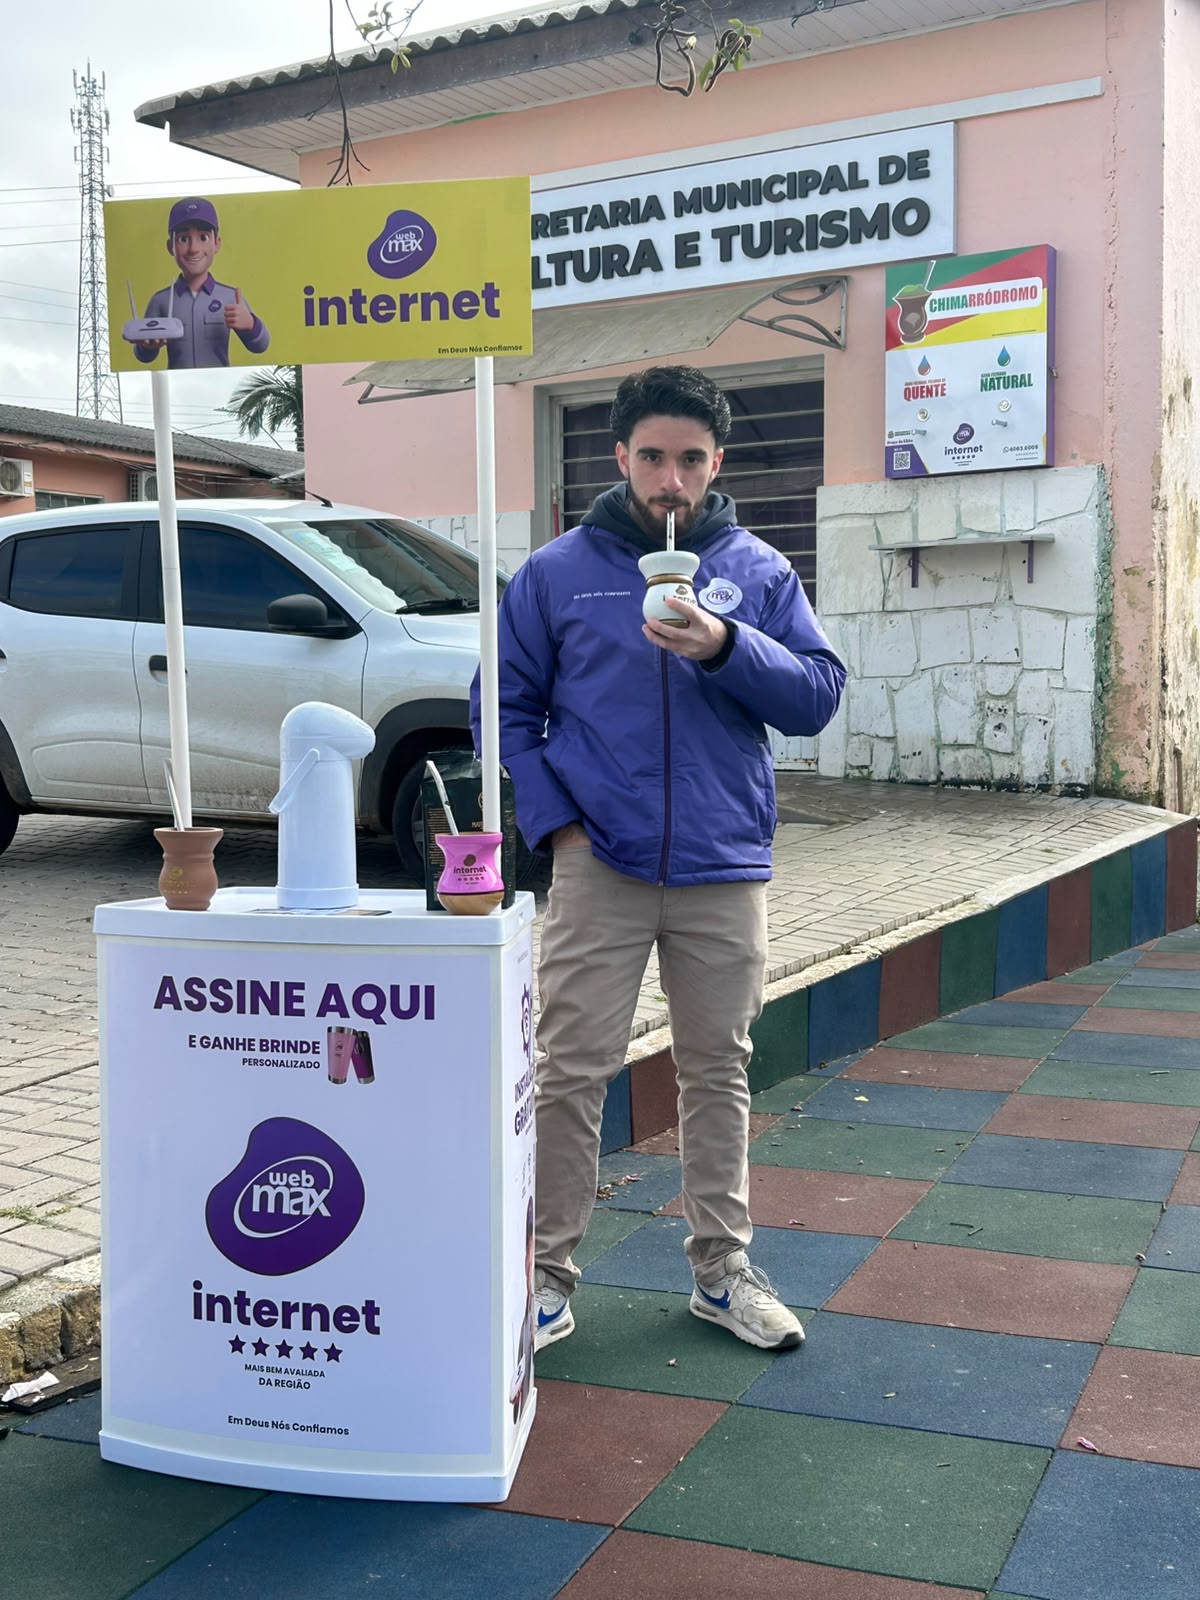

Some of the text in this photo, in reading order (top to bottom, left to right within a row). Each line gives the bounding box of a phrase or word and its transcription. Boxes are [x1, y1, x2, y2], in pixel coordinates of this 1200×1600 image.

[674, 161, 868, 217] MUNICIPAL
[878, 149, 930, 186] DE
[395, 231, 416, 240] web
[675, 231, 701, 269] E
[711, 197, 930, 263] TURISMO
[388, 239, 423, 253] max
[303, 282, 500, 327] internet
[929, 285, 1038, 313] CHIMARRÓDROMO
[469, 345, 482, 353] Nós
[484, 344, 523, 352] Confiamos
[980, 373, 1033, 392] NATURAL
[903, 383, 946, 402] QUENTE
[944, 444, 983, 456] internet
[453, 865, 487, 874] internet
[153, 975, 435, 1025] ASSINE AQUI
[188, 1035, 320, 1055] E GANHE BRINDE
[242, 1058, 320, 1069] PERSONALIZADO
[269, 1170, 314, 1187] web
[252, 1184, 331, 1217] max
[192, 1279, 381, 1336] internet
[244, 1363, 325, 1378] MAIS BEM AVALIADA
[258, 1377, 311, 1390] DA REGIÃO
[228, 1415, 350, 1436] Em Deus Nós Confiamos
